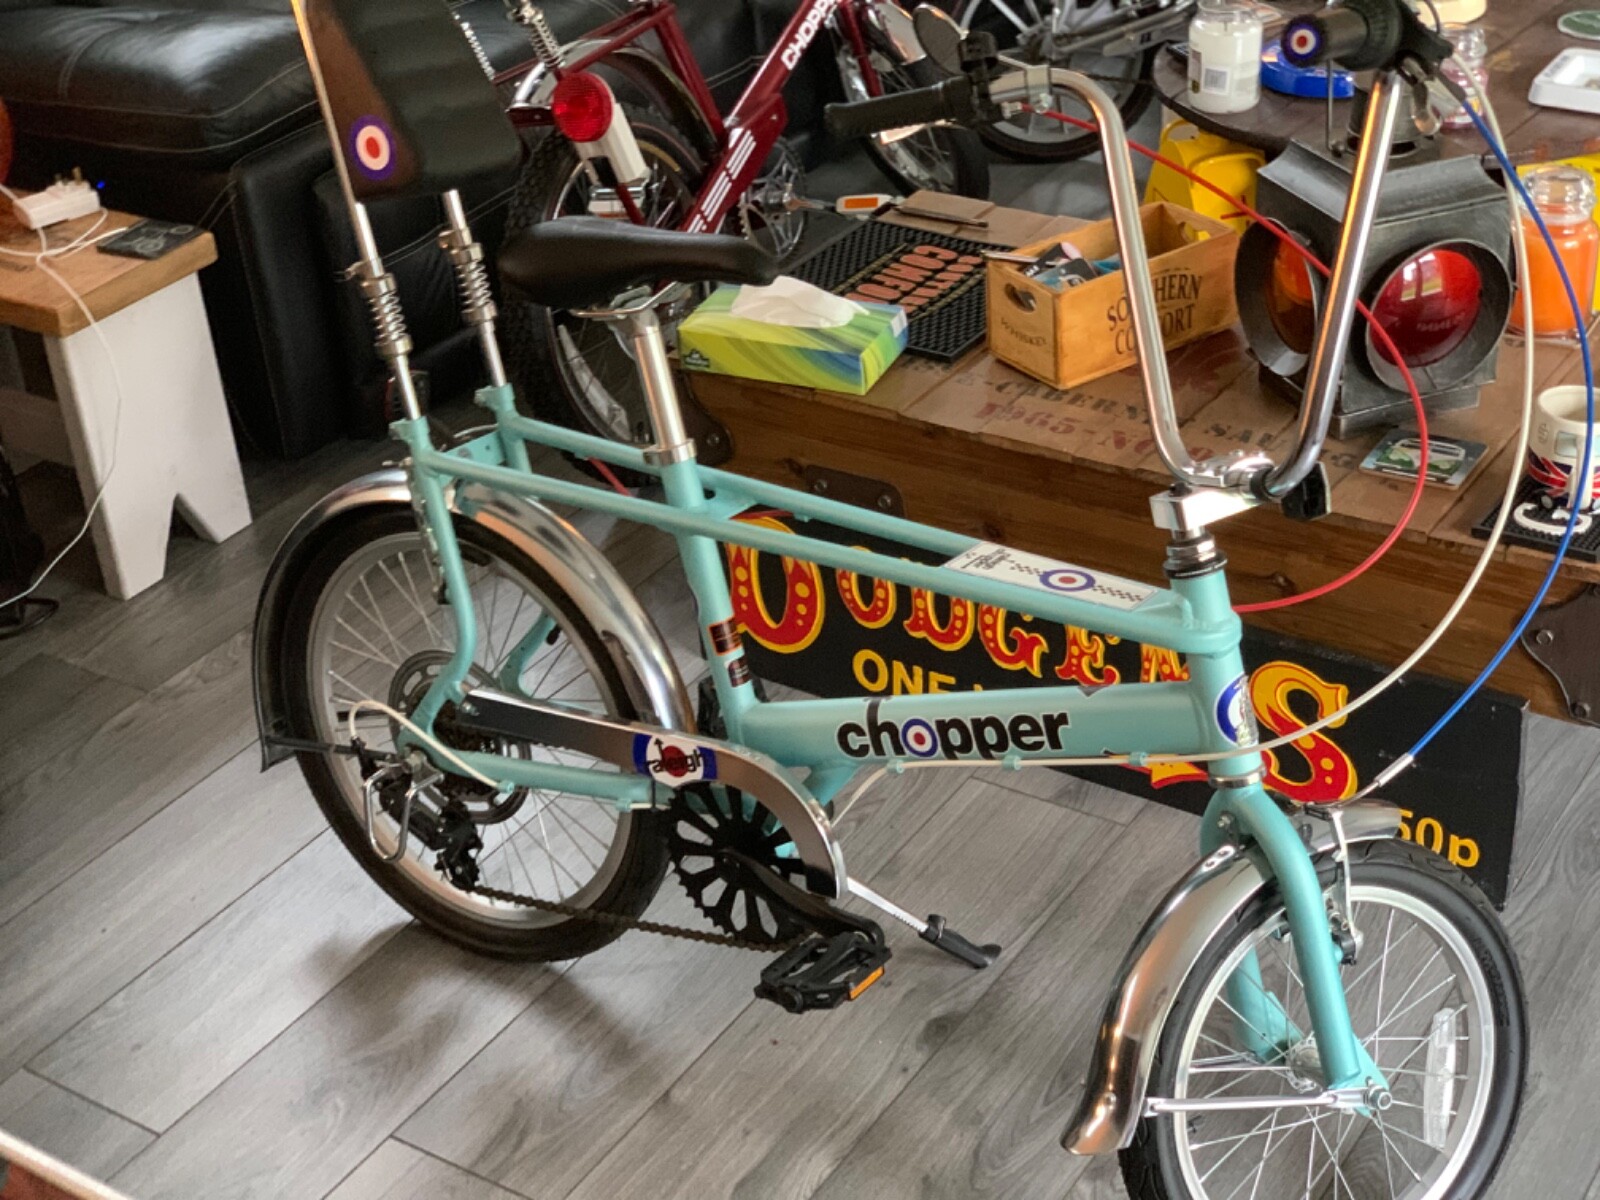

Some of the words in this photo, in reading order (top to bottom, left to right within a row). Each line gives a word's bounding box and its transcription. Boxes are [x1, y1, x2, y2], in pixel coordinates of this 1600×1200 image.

[781, 0, 835, 70] CHOPP
[1107, 274, 1202, 331] SOHERN
[1115, 303, 1195, 355] COORT
[836, 696, 1070, 761] chopper
